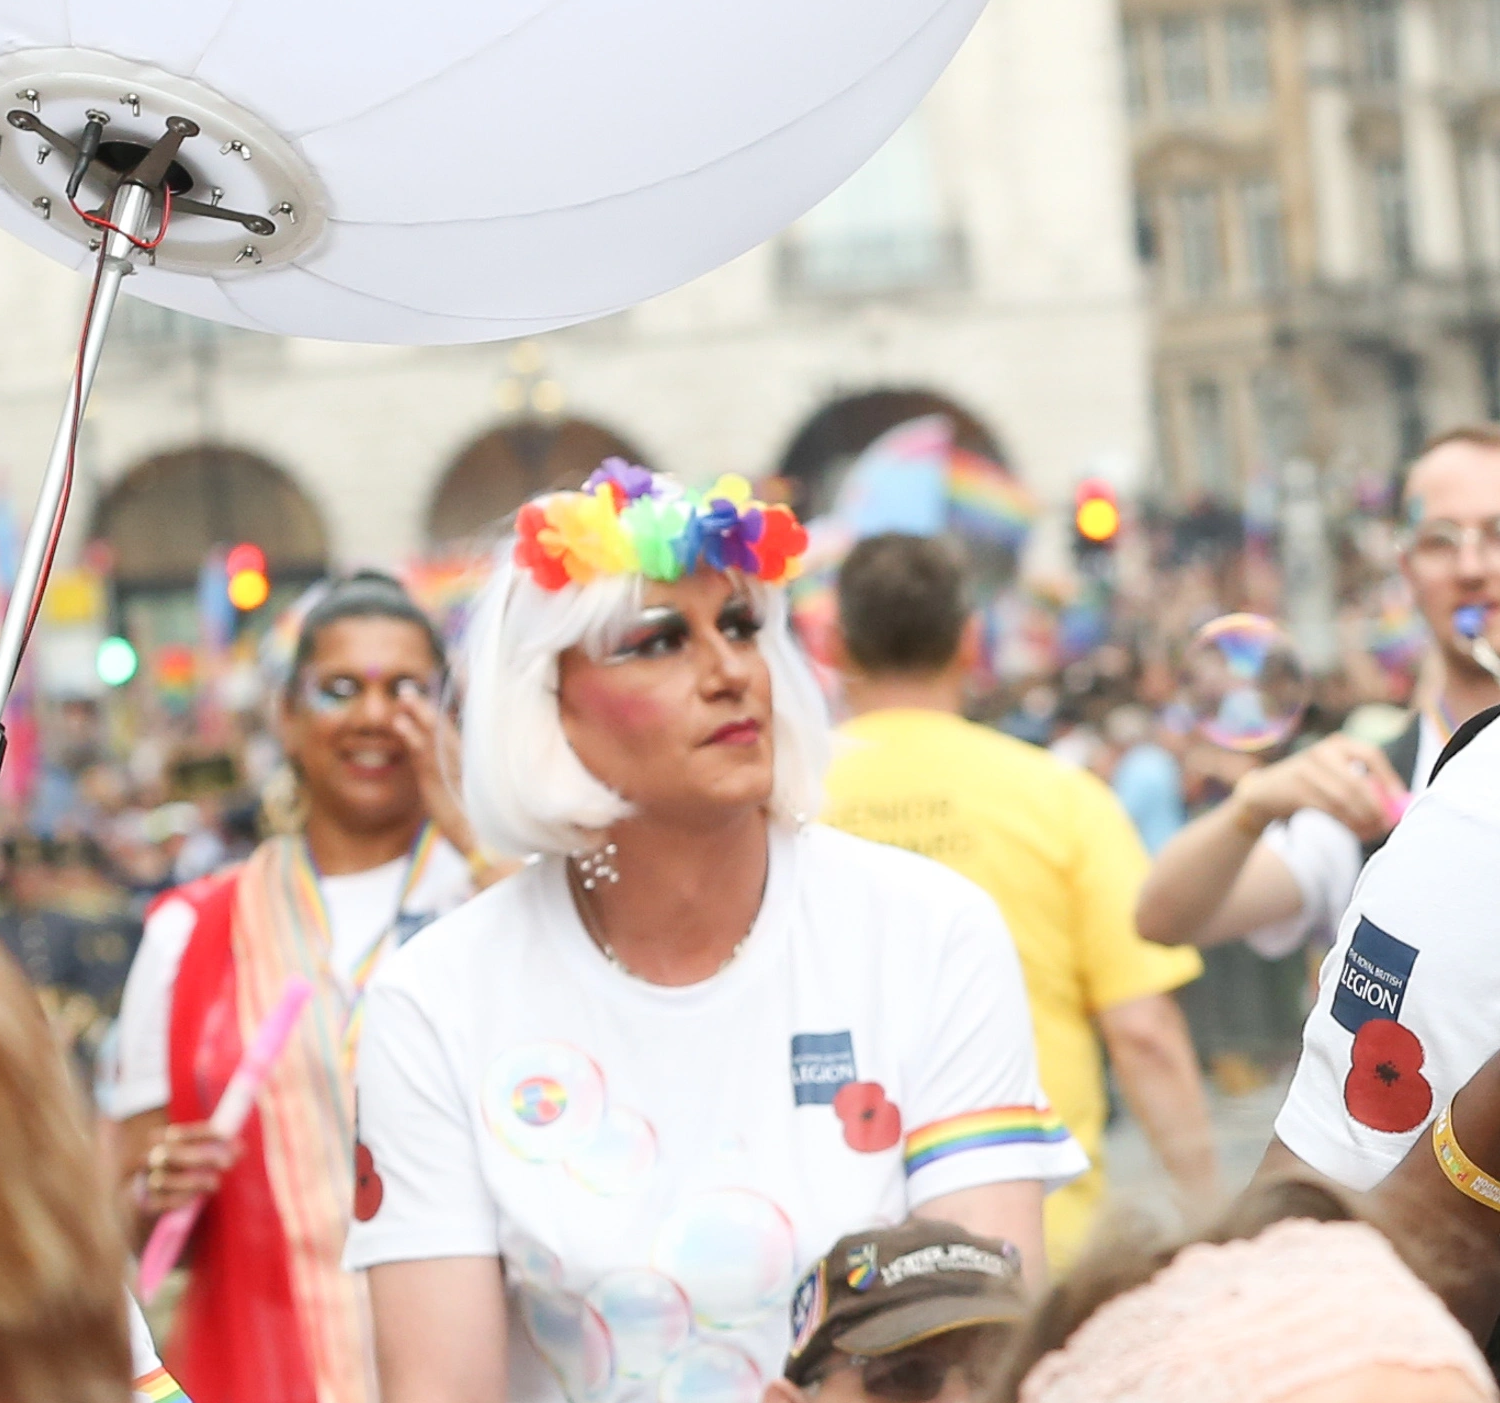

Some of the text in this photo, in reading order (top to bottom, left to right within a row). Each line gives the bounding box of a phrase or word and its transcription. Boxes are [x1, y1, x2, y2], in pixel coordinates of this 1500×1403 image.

[1341, 962, 1399, 1015] LEGION
[1357, 955, 1375, 975] ROYAL
[1374, 967, 1403, 989] BRITISH
[791, 1063, 854, 1085] LEGION
